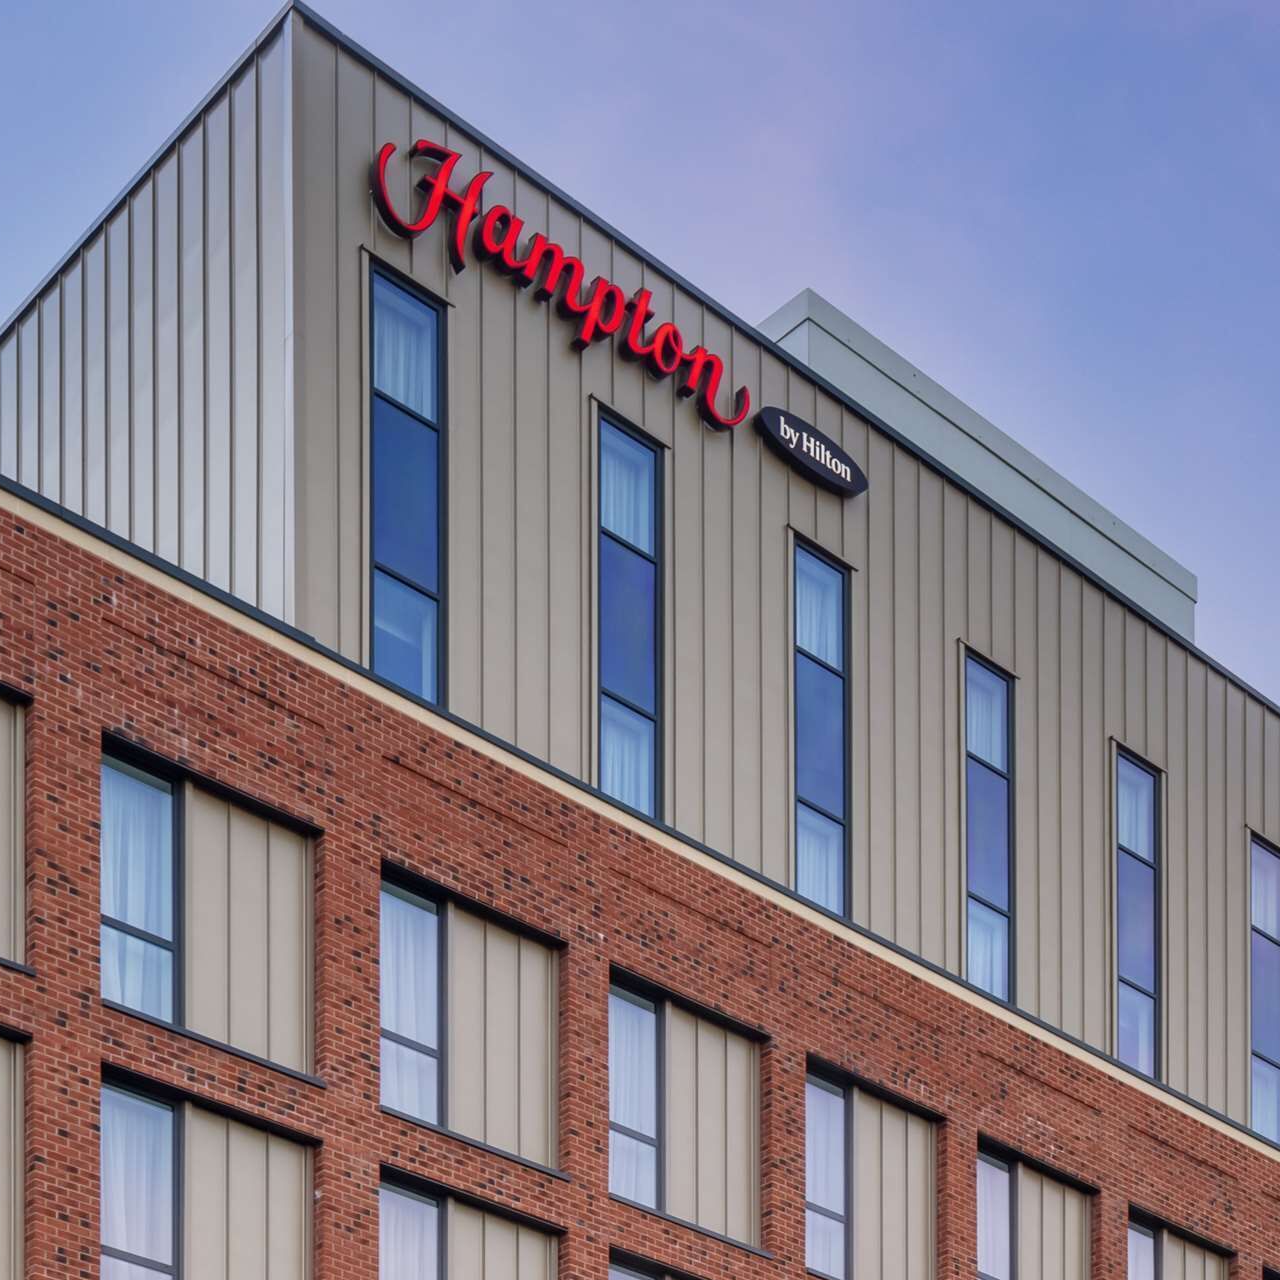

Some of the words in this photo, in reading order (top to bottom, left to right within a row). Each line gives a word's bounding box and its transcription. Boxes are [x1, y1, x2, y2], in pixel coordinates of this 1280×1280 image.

[373, 139, 751, 428] Hampton
[779, 415, 800, 449] by
[802, 431, 852, 482] Hilton
